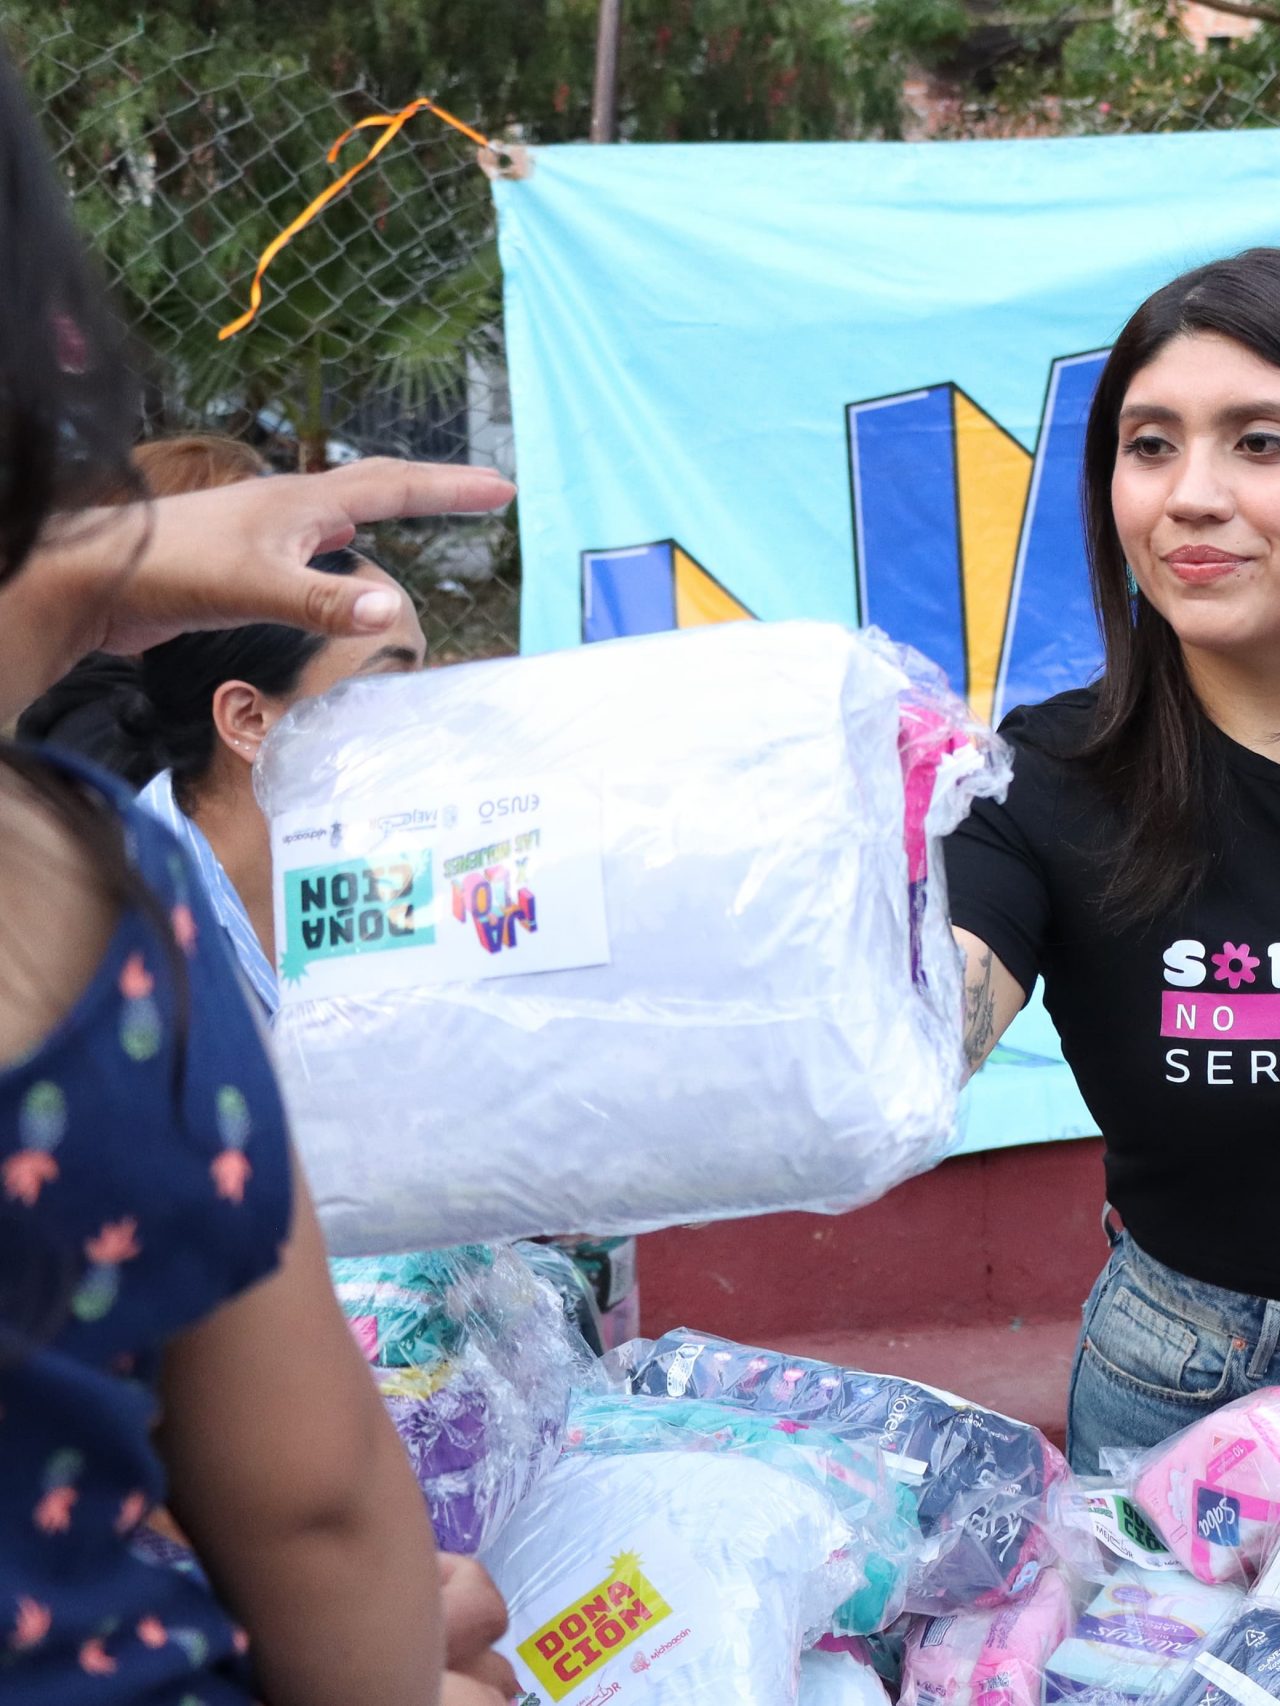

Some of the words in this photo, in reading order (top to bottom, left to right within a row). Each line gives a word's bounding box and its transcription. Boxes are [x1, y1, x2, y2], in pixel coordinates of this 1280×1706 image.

[1176, 1004, 1235, 1031] NO
[1165, 1049, 1280, 1085] SER
[1198, 1497, 1235, 1538] Saba
[535, 1581, 634, 1660] DONA
